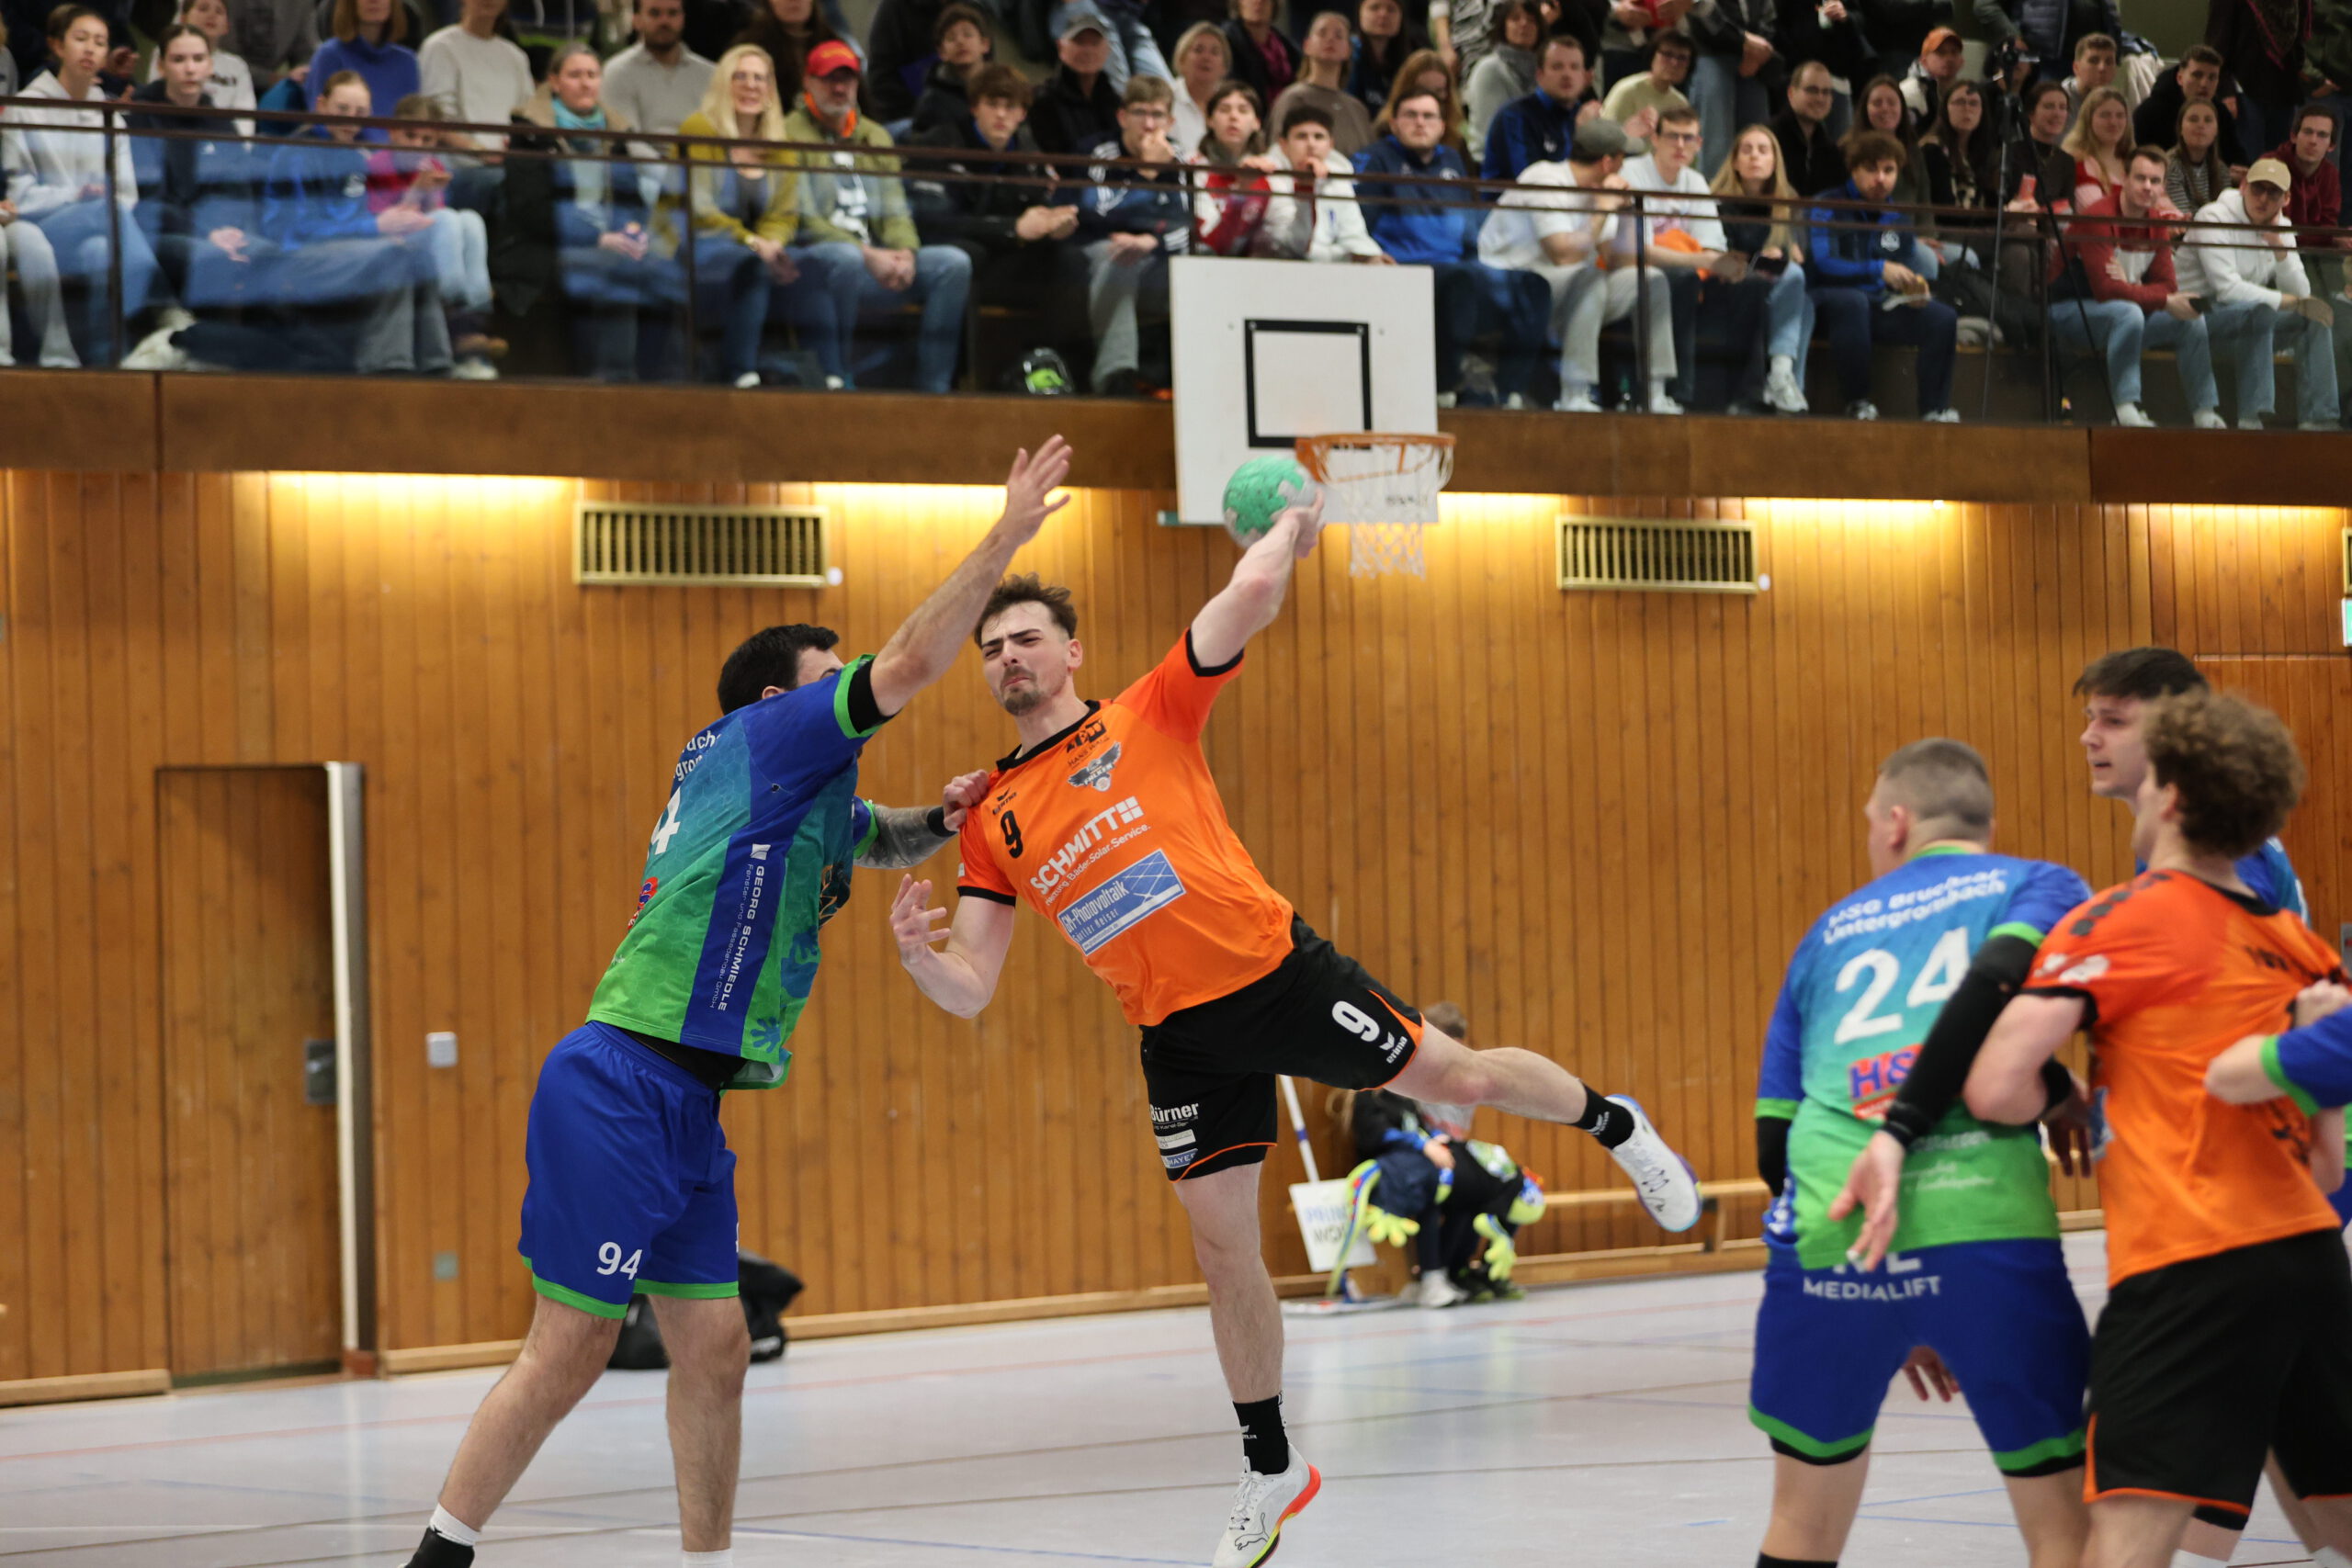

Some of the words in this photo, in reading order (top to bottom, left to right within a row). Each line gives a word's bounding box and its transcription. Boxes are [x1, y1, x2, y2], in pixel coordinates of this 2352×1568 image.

[647, 786, 681, 857] 4
[1001, 809, 1023, 859] 9
[1030, 807, 1119, 895] SCHMITT
[741, 863, 753, 900] Fenster
[747, 865, 764, 919] GEORG
[737, 903, 745, 919] und
[718, 921, 741, 979] Fassadenbau
[718, 925, 752, 1011] SCHMIEDLE
[710, 980, 723, 1009] GmbH
[1834, 926, 1970, 1045] 24
[1332, 1000, 1380, 1043] 9
[1386, 1036, 1408, 1065] erima
[597, 1242, 643, 1280] 94
[1803, 1275, 1941, 1302] MEDIALIFT
